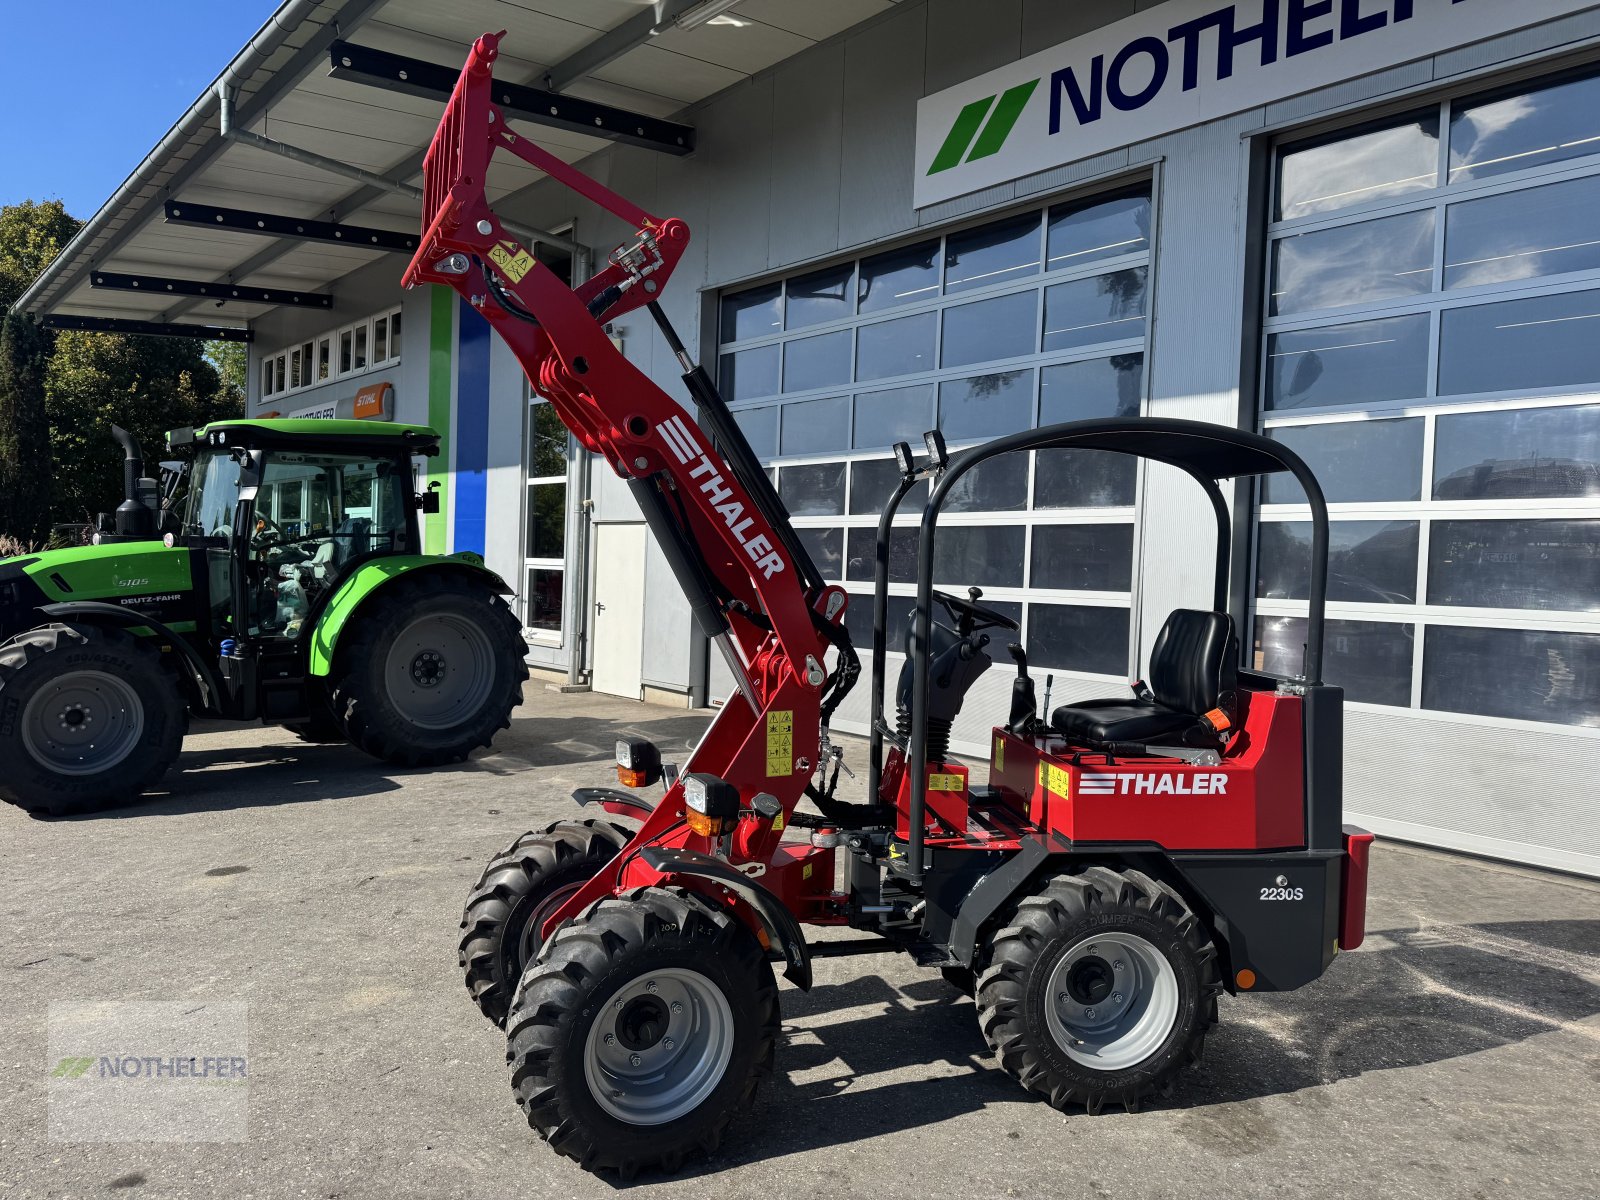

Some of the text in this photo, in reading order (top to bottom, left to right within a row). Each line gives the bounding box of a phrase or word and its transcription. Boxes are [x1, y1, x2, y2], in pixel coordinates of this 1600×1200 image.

[1048, 0, 1466, 135] NOTHEL
[357, 393, 376, 406] STIHL
[689, 455, 785, 580] THALER
[120, 594, 181, 605] DEUTZ-FAHR
[1117, 773, 1229, 795] THALER
[1259, 887, 1304, 901] 2230S
